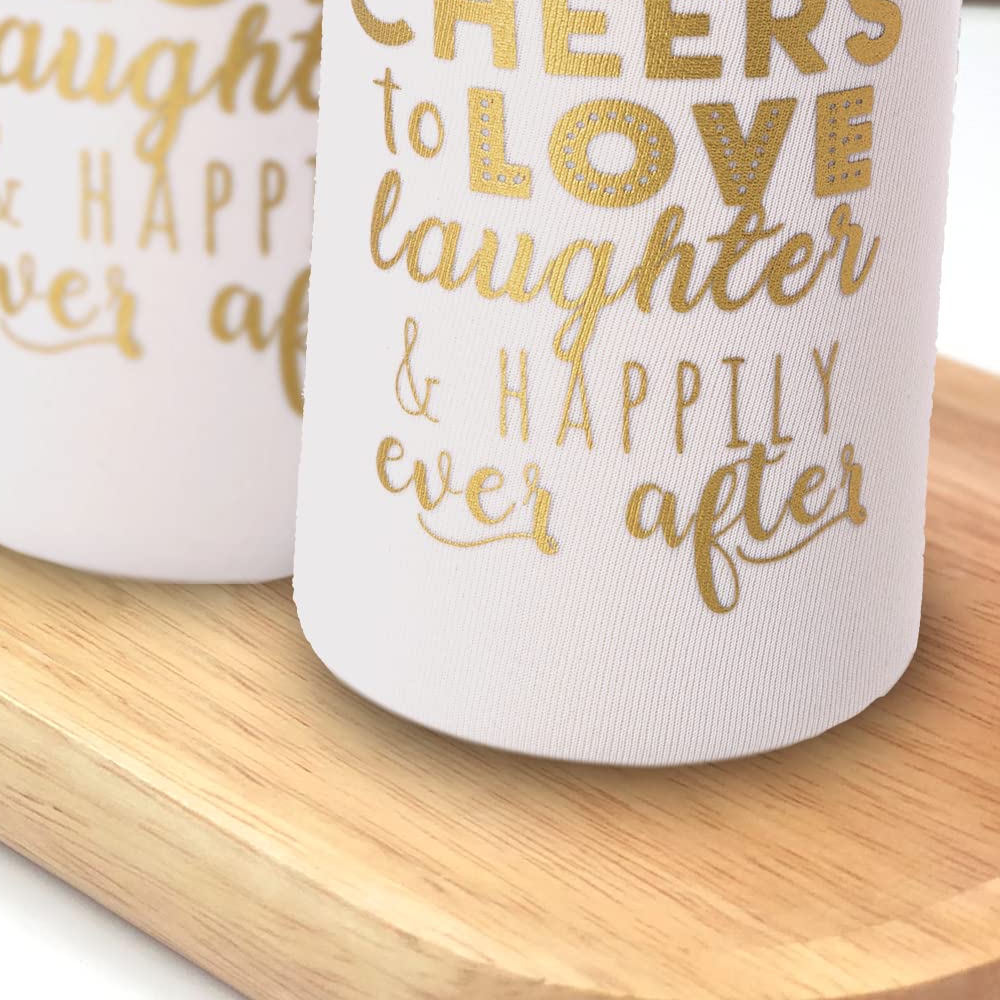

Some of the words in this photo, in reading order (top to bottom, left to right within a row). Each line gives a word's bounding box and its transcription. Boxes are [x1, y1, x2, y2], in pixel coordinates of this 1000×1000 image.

[79, 148, 316, 258] HAPP
[372, 66, 446, 160] to
[466, 84, 876, 209] LOVE
[369, 168, 881, 364] laughter
[394, 316, 441, 423] &
[497, 339, 840, 456] HAPPILY
[375, 435, 560, 556] ever
[624, 441, 868, 615] after
